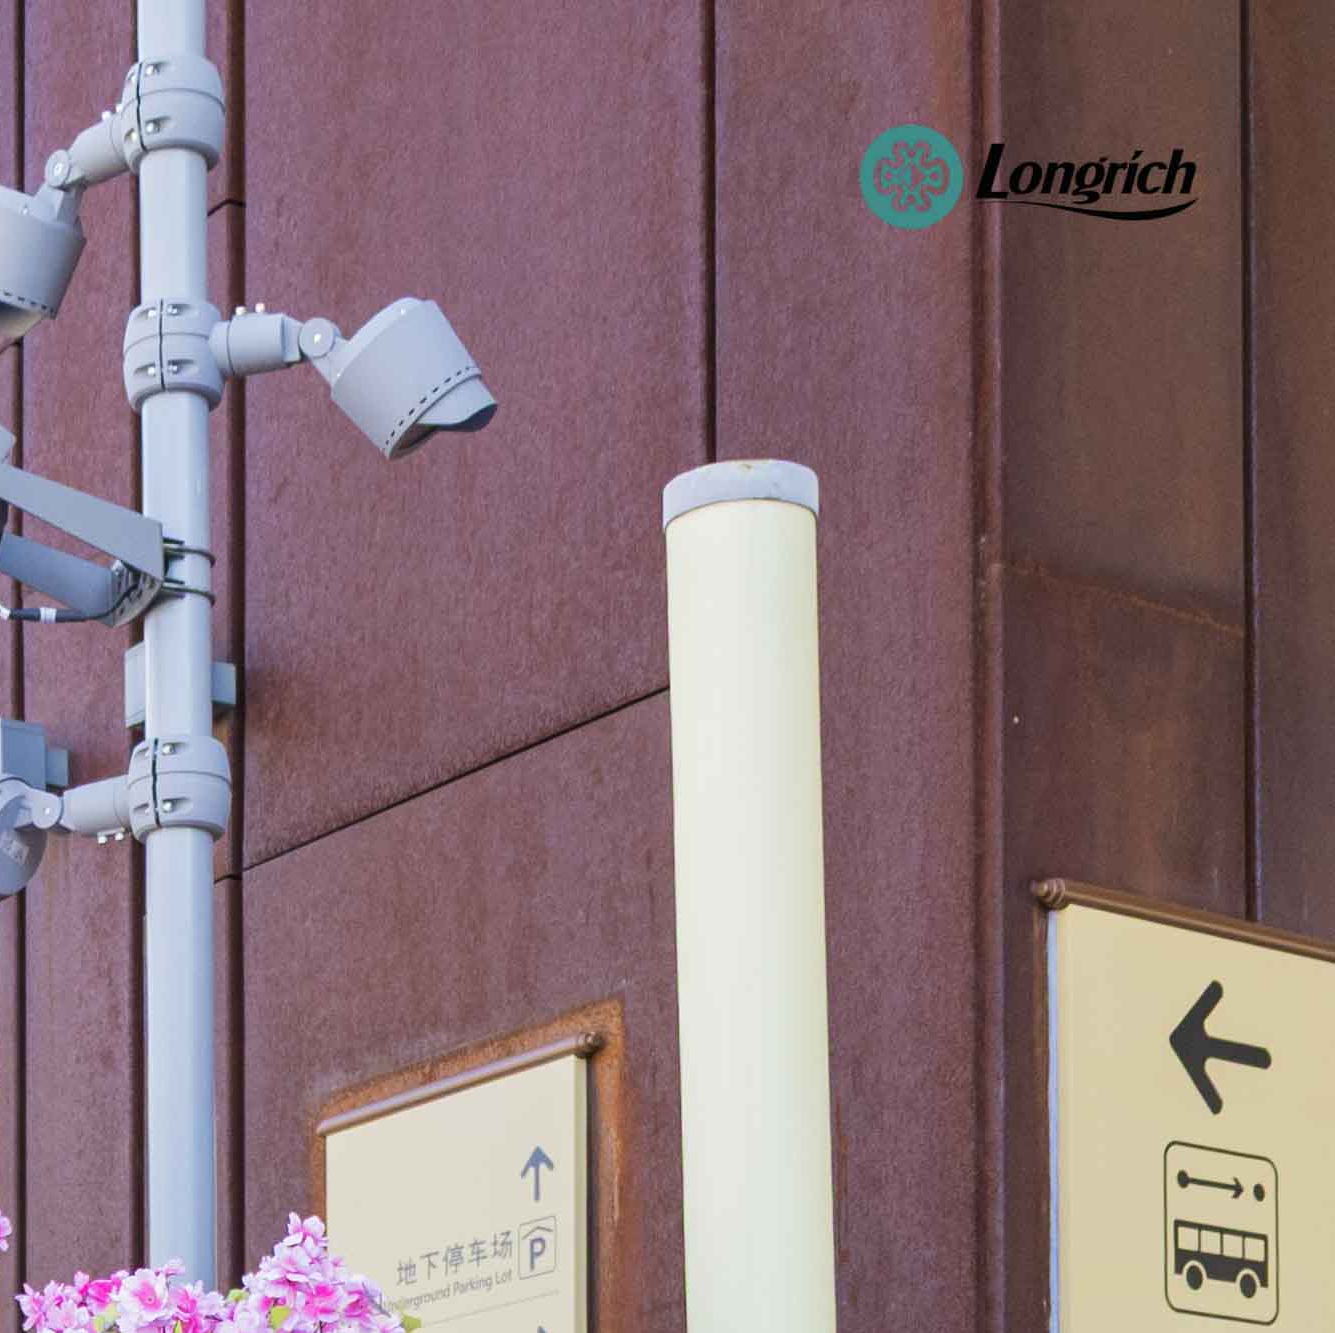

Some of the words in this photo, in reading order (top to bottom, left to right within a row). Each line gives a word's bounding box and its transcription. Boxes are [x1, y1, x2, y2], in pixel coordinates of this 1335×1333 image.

[396, 1229, 513, 1287] 地下停车场
[452, 1274, 493, 1297] Parking
[495, 1268, 513, 1286] Lot
